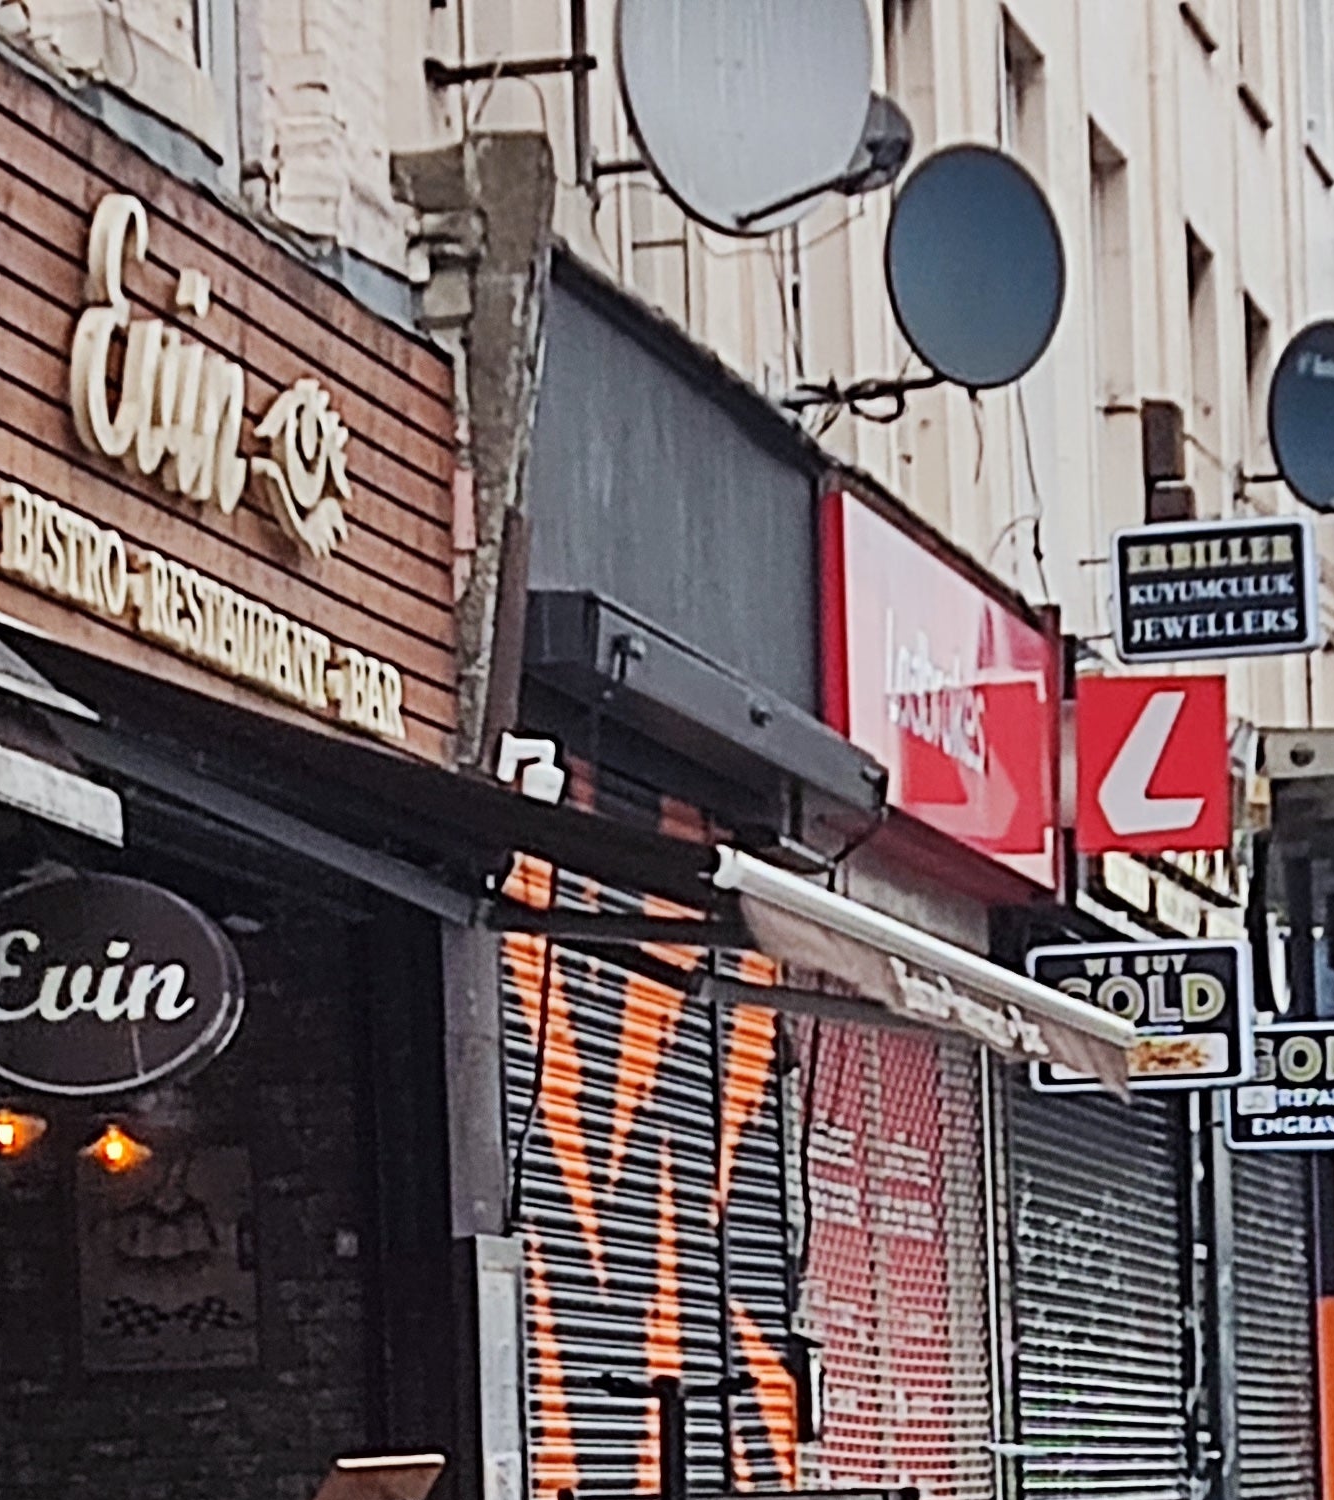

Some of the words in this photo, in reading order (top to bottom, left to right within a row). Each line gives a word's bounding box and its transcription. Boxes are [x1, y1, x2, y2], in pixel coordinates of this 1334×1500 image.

[1129, 572, 1295, 605] KUYUMCULUK
[1131, 608, 1299, 644] JEWELLERS
[1134, 954, 1187, 975] BUY
